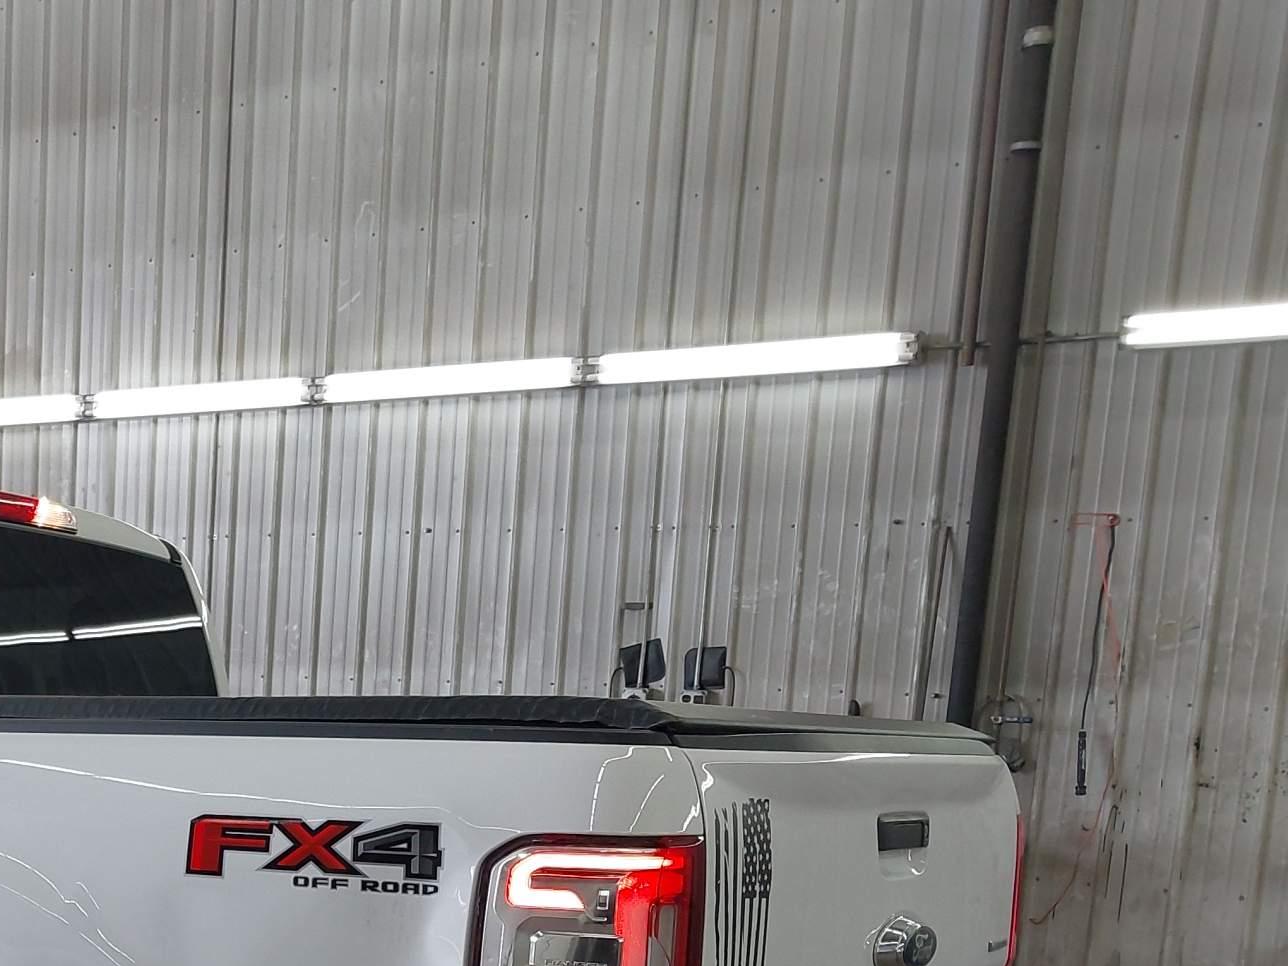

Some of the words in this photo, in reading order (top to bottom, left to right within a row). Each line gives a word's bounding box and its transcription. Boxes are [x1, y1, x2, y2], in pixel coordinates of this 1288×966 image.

[185, 813, 445, 881] FX4
[292, 875, 349, 890] OFF
[360, 879, 439, 896] ROAD
